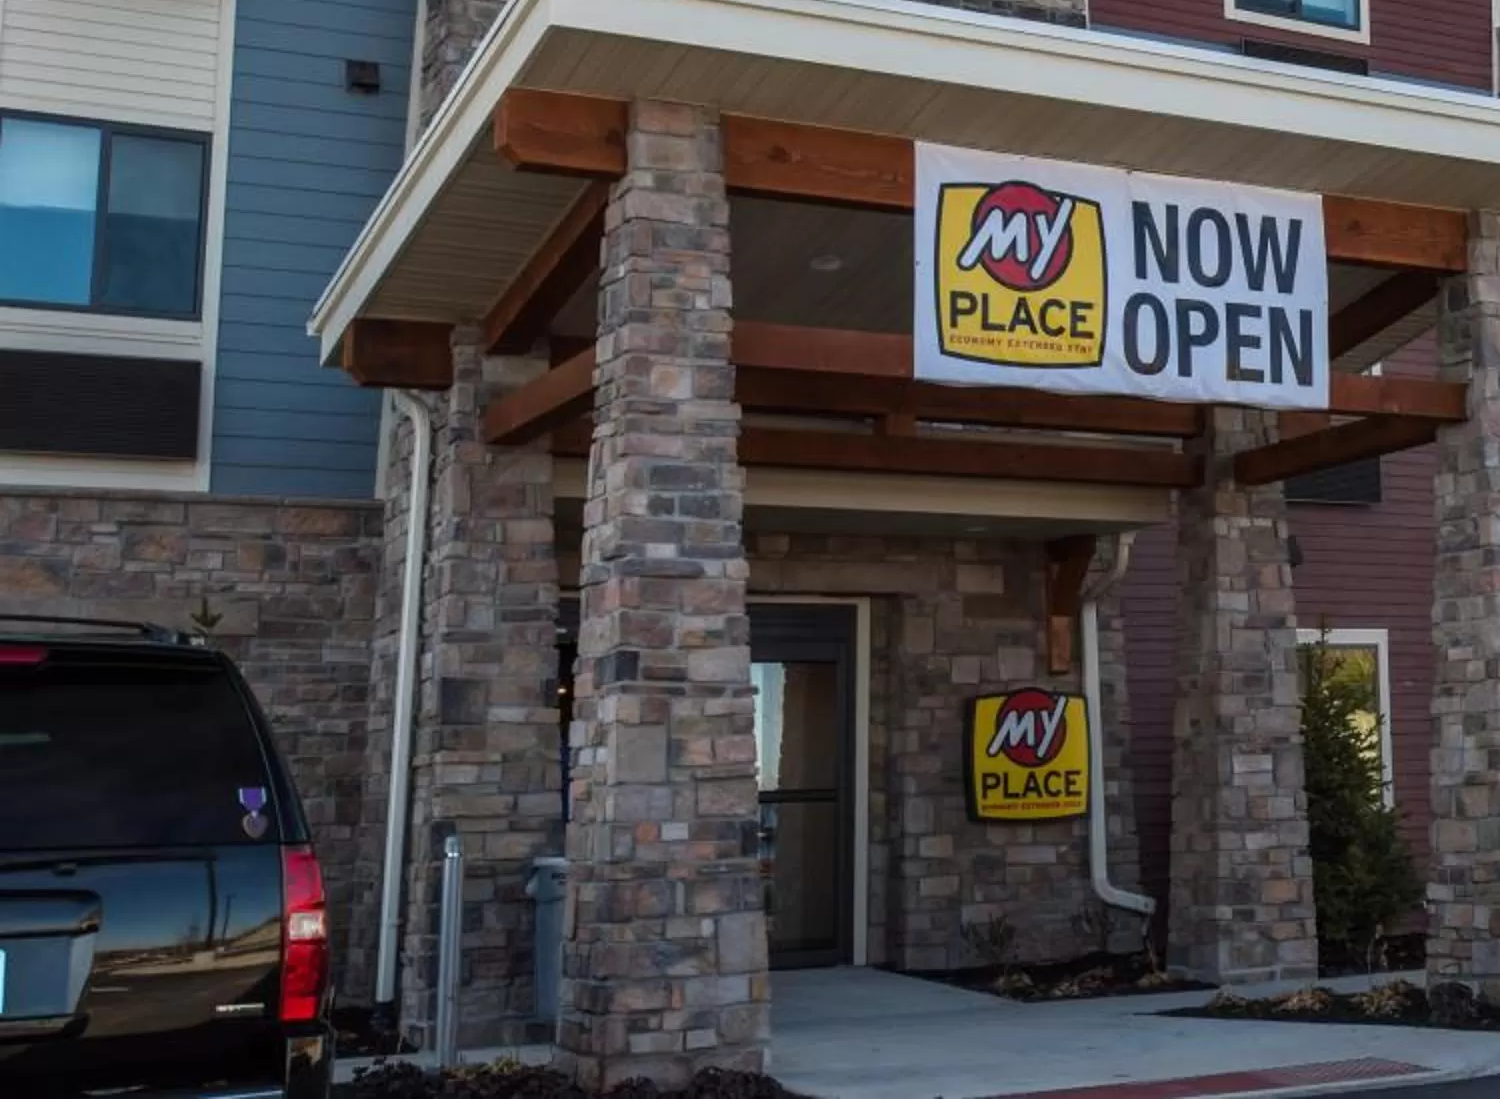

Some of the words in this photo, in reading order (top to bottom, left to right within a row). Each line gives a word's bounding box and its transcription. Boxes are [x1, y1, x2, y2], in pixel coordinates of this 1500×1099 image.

[1131, 200, 1303, 295] NOW
[949, 290, 1095, 340] PLACE
[1123, 291, 1313, 387] OPEN
[981, 770, 1082, 800] PLACE
